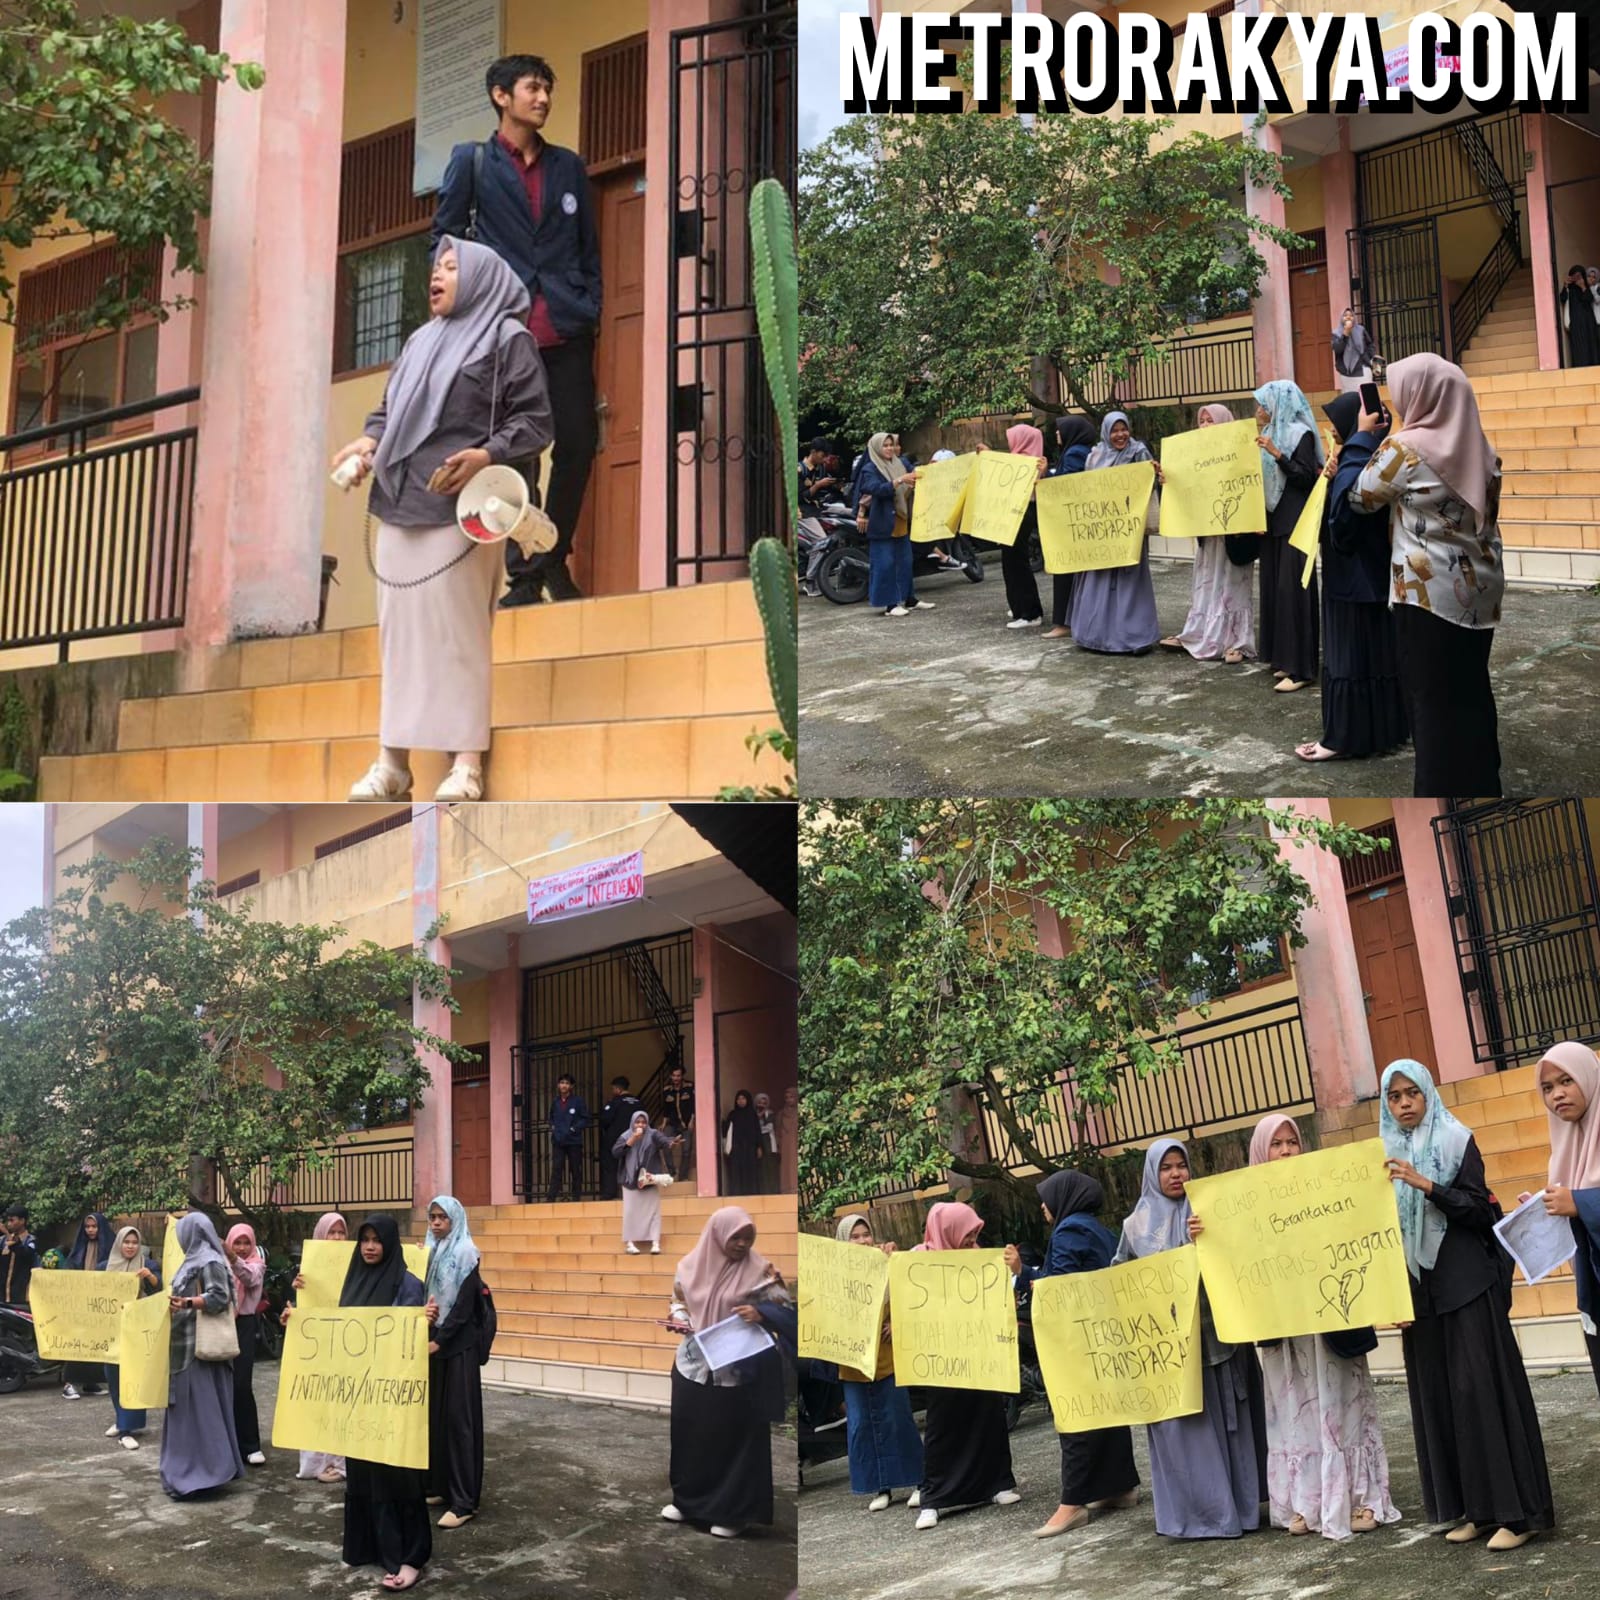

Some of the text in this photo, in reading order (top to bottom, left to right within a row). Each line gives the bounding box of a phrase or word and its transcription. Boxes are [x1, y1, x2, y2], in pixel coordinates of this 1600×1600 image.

[1268, 1196, 1356, 1235] Berantakan
[842, 1276, 873, 1306] HARUS
[1109, 1259, 1190, 1308] HARUS
[300, 1314, 417, 1361] STOP!!
[912, 1353, 971, 1378] OTONOMI
